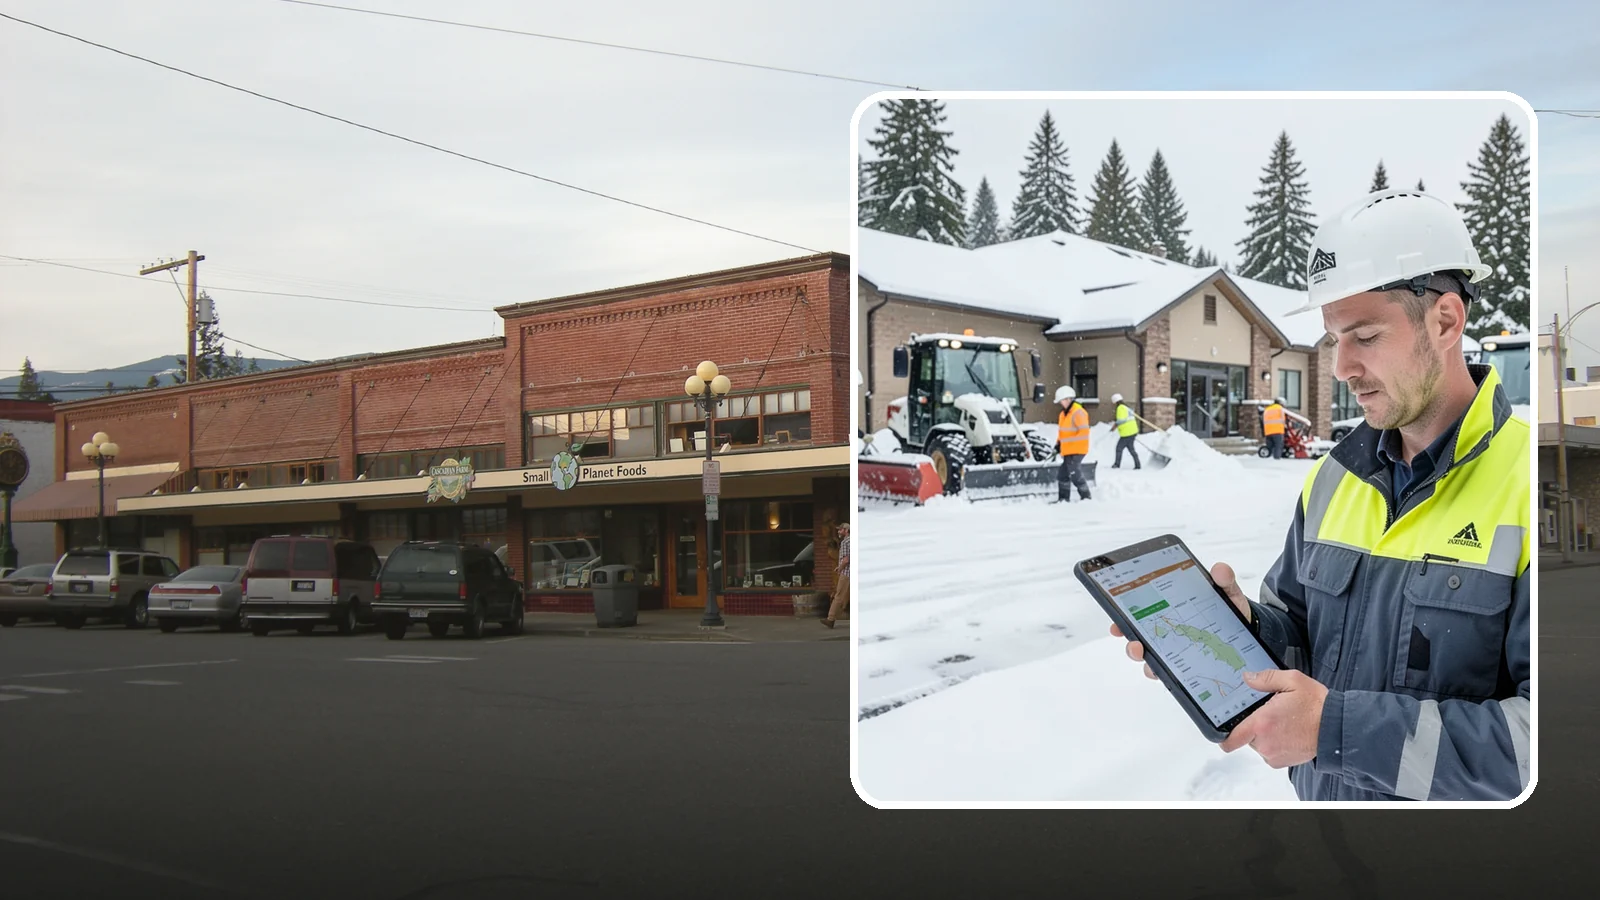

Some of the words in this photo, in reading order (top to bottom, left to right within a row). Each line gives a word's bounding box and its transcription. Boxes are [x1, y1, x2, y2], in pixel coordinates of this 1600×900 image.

[523, 471, 549, 483] Small
[582, 467, 614, 479] Planet
[616, 464, 647, 477] Foods
